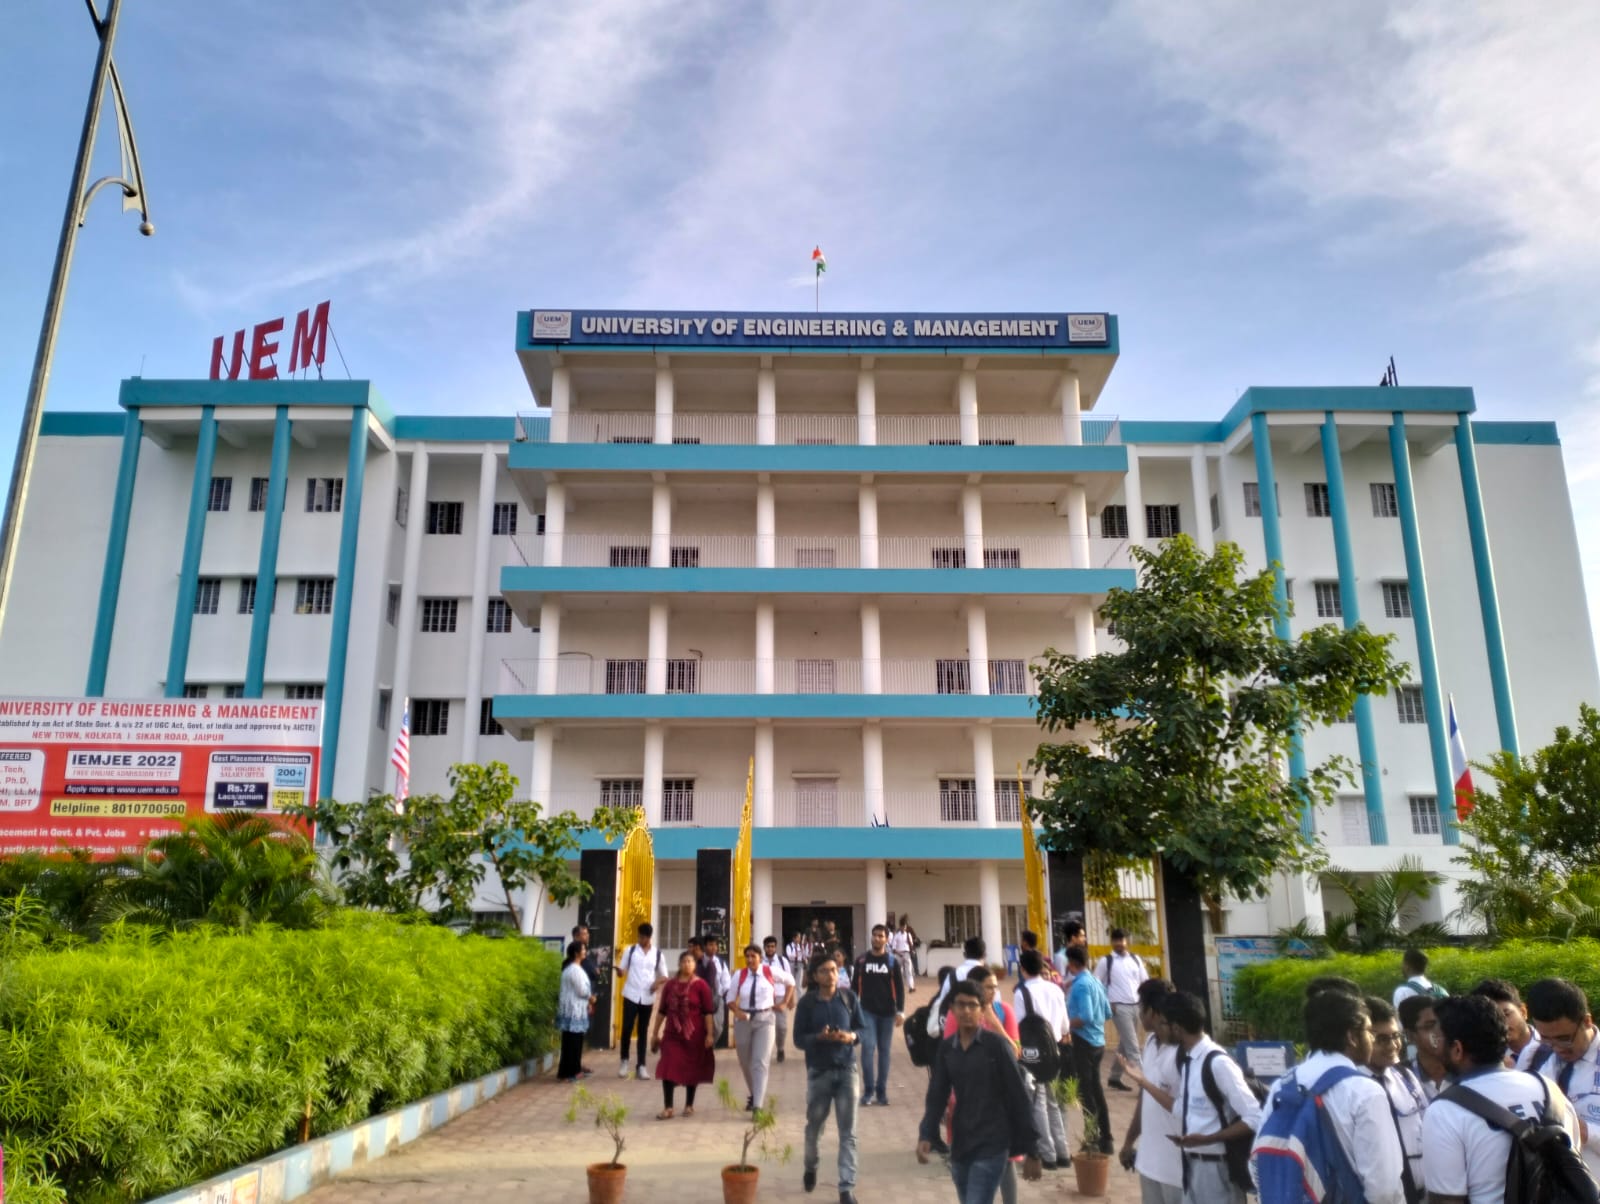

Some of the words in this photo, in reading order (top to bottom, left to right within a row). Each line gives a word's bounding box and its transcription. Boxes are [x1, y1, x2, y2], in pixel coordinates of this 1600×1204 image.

[581, 316, 706, 336] UNIVERSITY
[711, 318, 738, 335] OF
[743, 319, 886, 336] ENGINEERING
[892, 320, 909, 336] &
[914, 320, 1059, 337] MANAGEMENT
[209, 300, 330, 380] UEM
[78, 703, 97, 716] OF
[101, 703, 197, 718] ENGINEERING
[202, 704, 212, 718] &
[217, 705, 319, 720] MANAGEMENT
[32, 720, 40, 728] by
[171, 722, 185, 730] Act,
[250, 723, 281, 731] approved
[72, 755, 132, 766] IEMJEE
[137, 756, 176, 767] 2022
[53, 803, 100, 814] Helpline
[112, 804, 185, 814] 8010700500
[104, 829, 126, 837] Jobs
[866, 963, 888, 973] FILA
